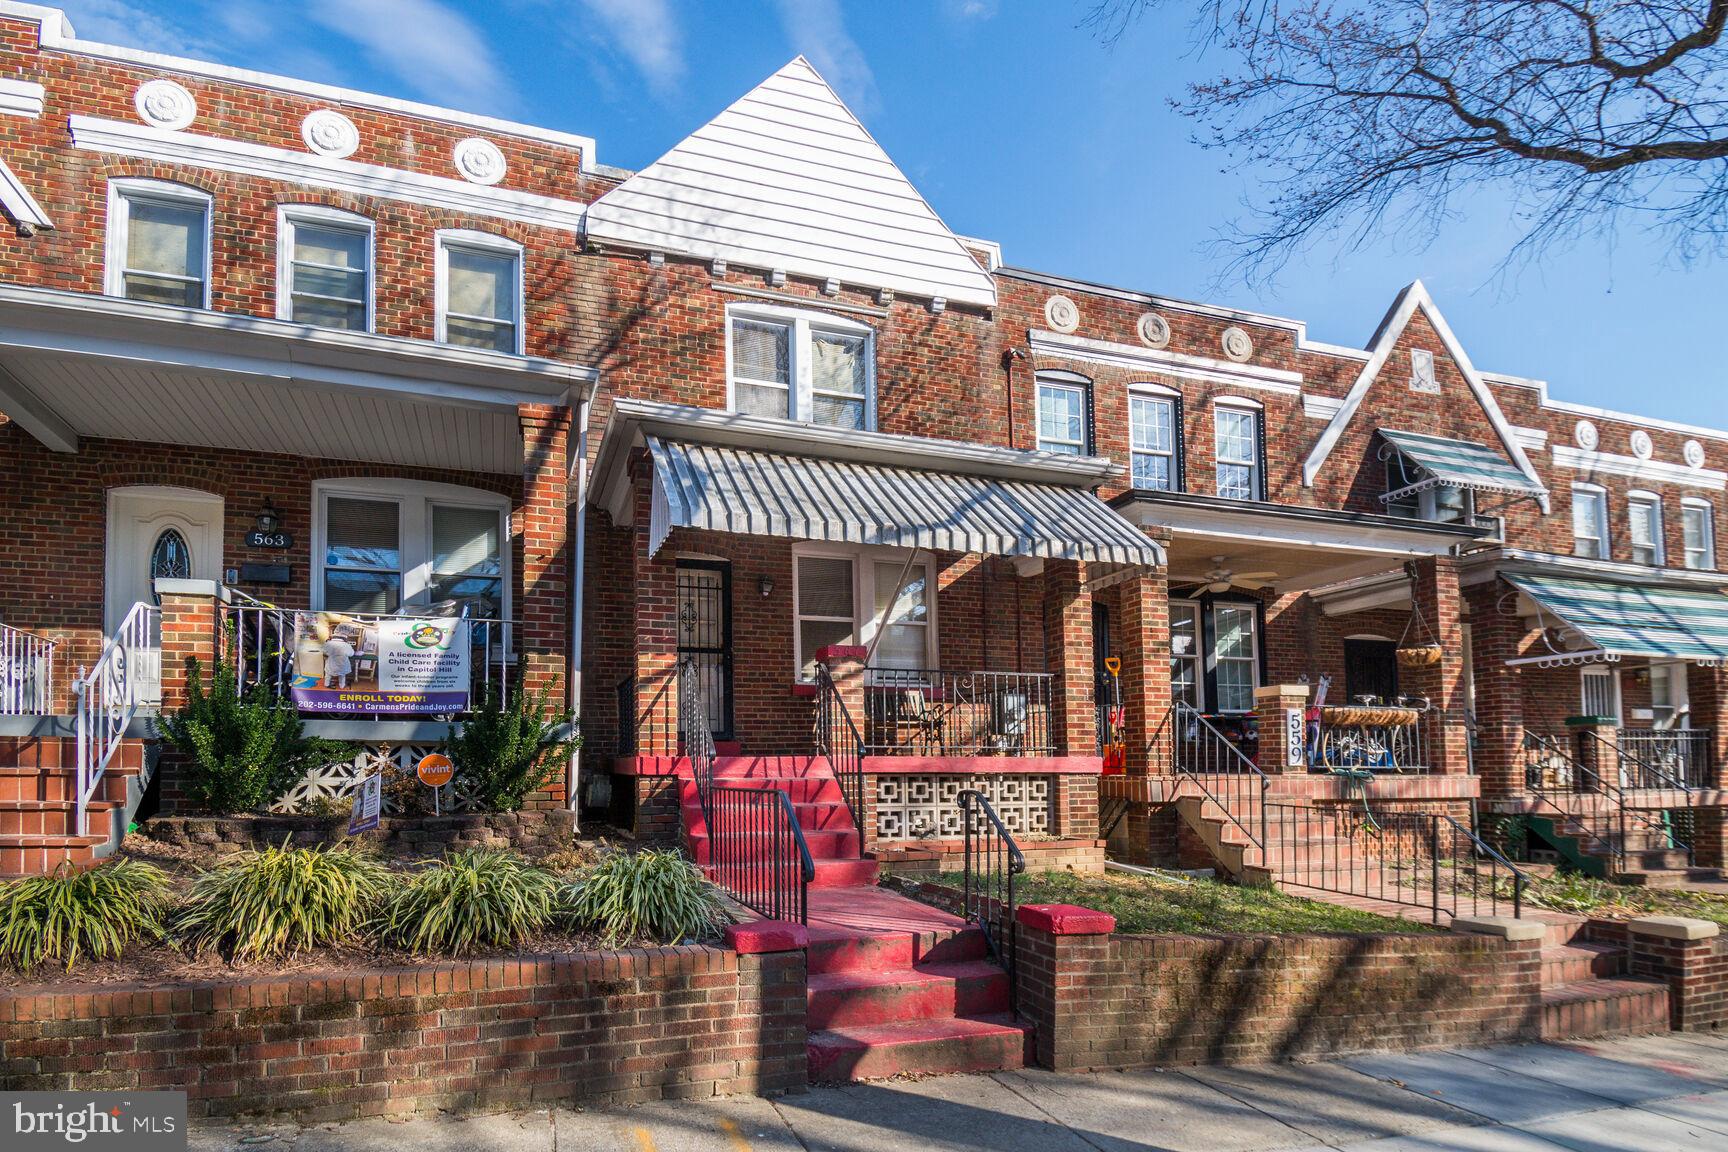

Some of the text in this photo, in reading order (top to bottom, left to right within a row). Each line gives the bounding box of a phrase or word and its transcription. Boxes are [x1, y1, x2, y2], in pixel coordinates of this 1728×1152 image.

[254, 533, 284, 546] 563
[434, 652, 460, 660] Family
[298, 700, 464, 712] 202-596-6641 CarmensPrideandJoy.com
[1290, 713, 1302, 764] 559
[422, 764, 451, 774] vivint
